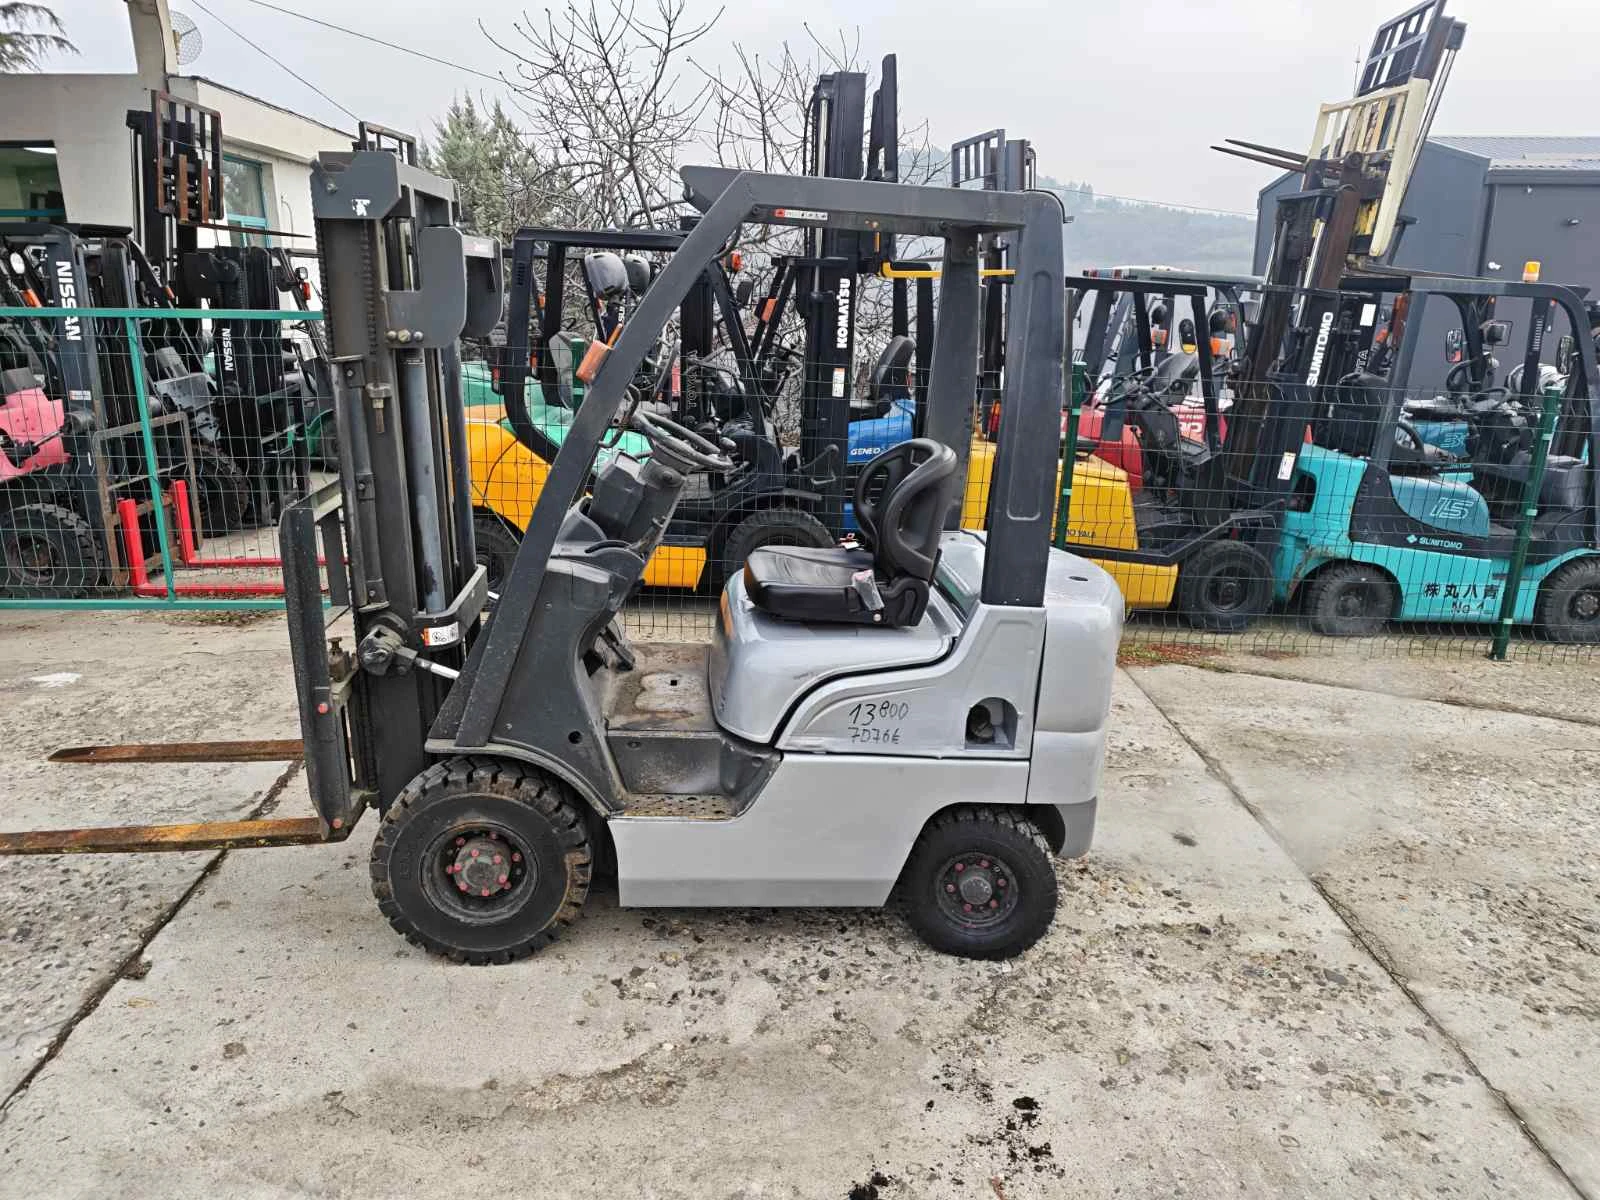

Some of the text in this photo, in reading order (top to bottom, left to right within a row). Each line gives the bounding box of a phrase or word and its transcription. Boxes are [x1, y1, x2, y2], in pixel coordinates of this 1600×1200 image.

[56, 261, 82, 341] NISSAN
[836, 278, 851, 349] KOMATSU
[221, 328, 234, 371] NISSAN
[1306, 311, 1334, 387] SUMITOMO
[1429, 496, 1475, 519] 15
[1418, 537, 1463, 549] SUMITOMO
[848, 700, 910, 726] 13800
